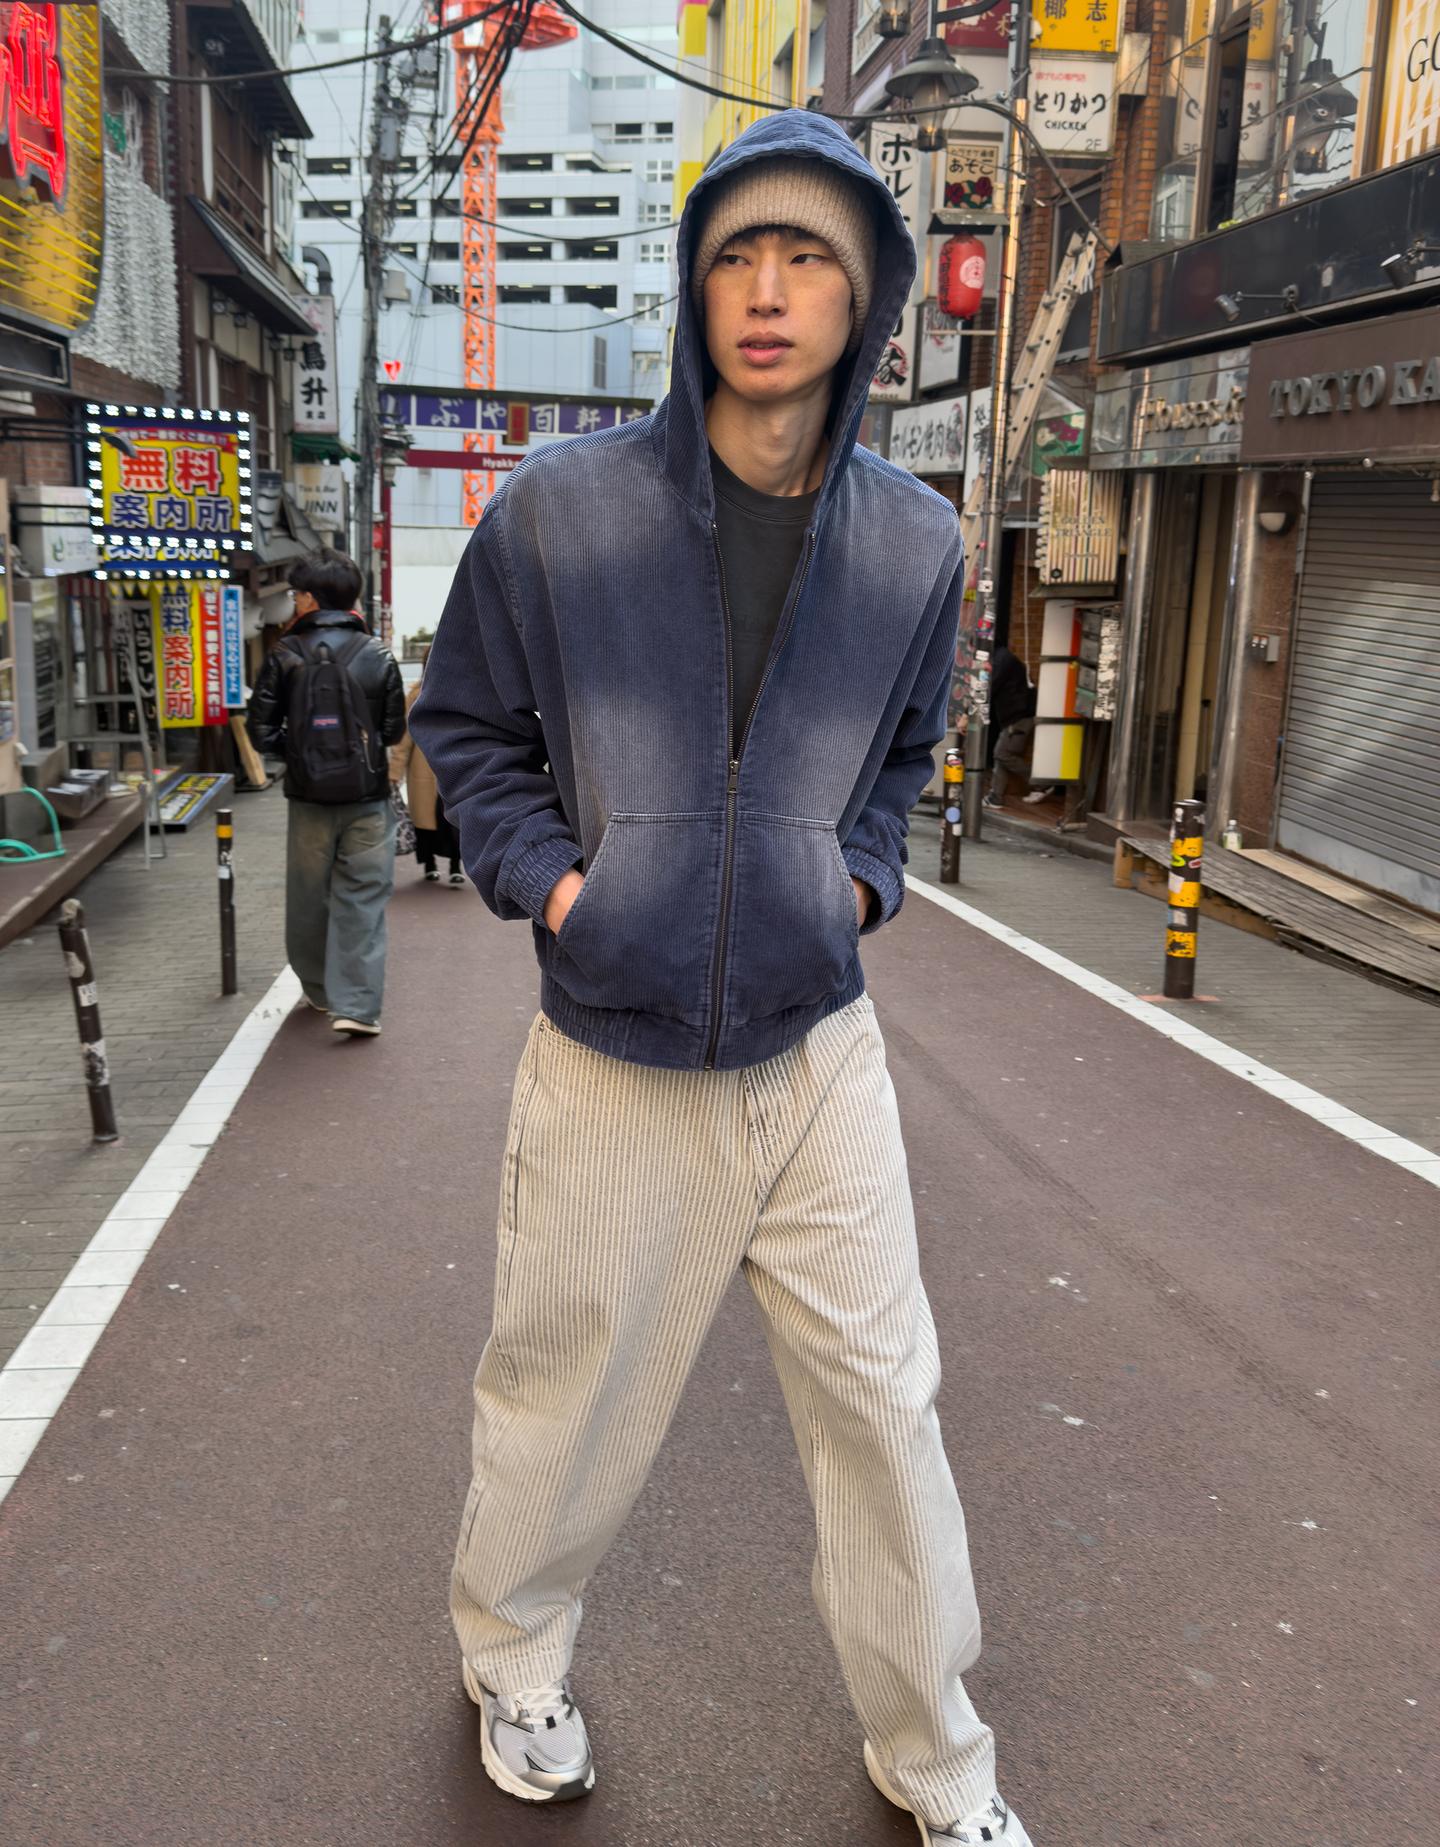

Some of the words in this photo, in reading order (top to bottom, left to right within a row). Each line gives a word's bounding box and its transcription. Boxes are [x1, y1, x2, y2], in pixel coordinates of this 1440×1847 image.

[1034, 91, 1106, 115] とりかつ
[1045, 120, 1087, 131] CHICKEN
[1085, 138, 1103, 151] 2F
[949, 158, 994, 175] あそこ
[1269, 365, 1386, 417] TOKYO
[120, 446, 222, 495] 無料
[110, 492, 233, 532] 案内所
